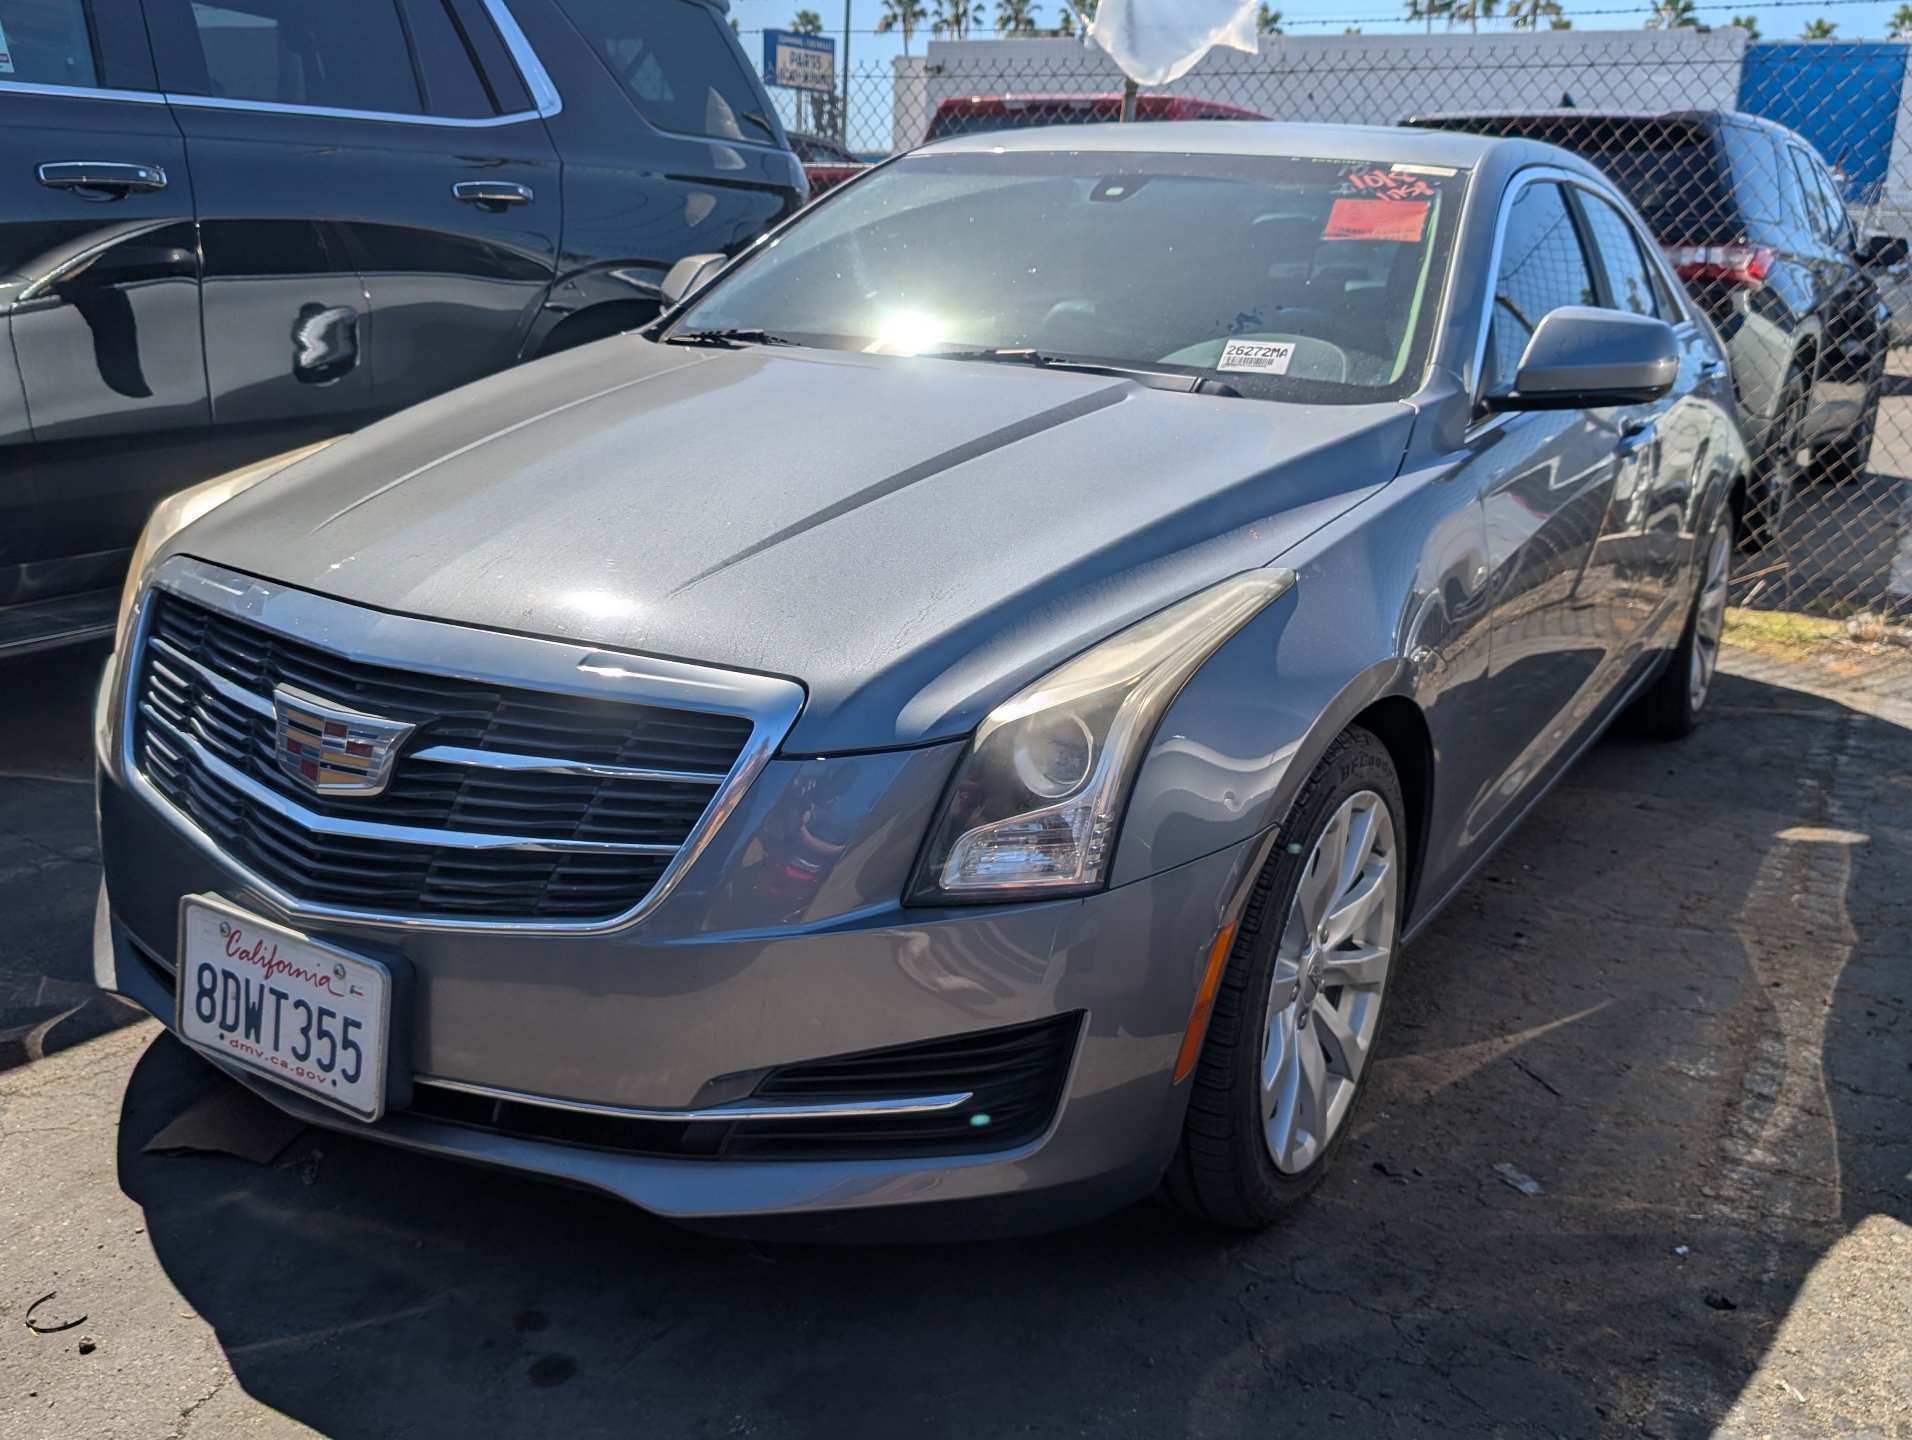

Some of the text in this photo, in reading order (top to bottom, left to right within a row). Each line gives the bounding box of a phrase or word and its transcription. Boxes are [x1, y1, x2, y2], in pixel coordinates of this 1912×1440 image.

[1226, 345, 1288, 358] 26272MA
[225, 929, 345, 998] California
[195, 962, 363, 1084] 8DWT355
[229, 1038, 327, 1084] dmv.ca.gov
